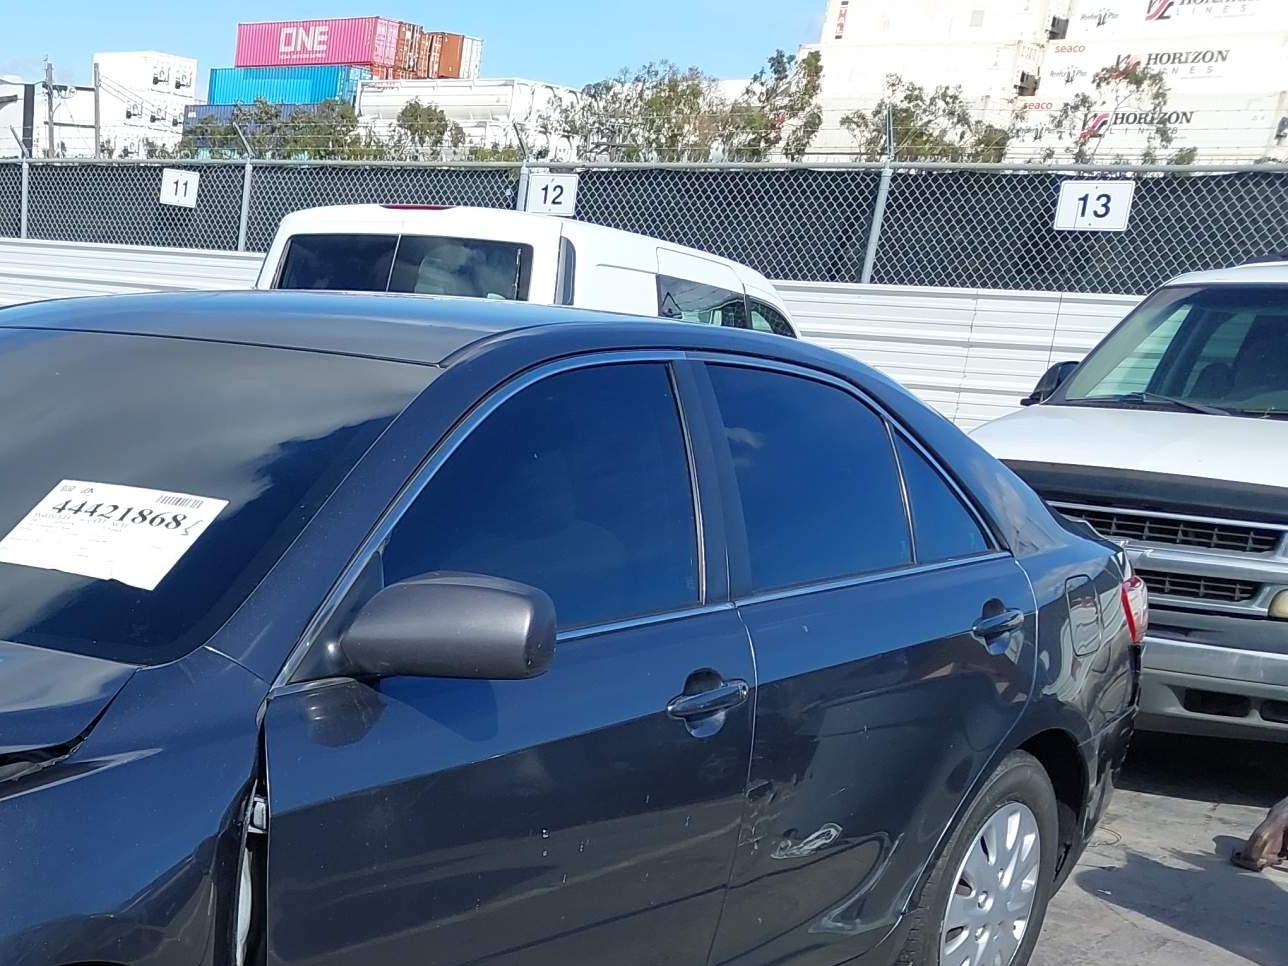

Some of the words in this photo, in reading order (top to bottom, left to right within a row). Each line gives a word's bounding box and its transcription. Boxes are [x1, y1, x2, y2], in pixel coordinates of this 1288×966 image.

[279, 26, 328, 53] ONE
[1055, 45, 1086, 53] seaco
[1145, 50, 1230, 66] HORIZON
[1023, 101, 1053, 110] seaco
[1112, 111, 1194, 125] HORIZON
[173, 179, 188, 197] 11
[541, 184, 564, 205] 12
[1077, 193, 1112, 218] 13
[52, 499, 187, 530] 44421868
